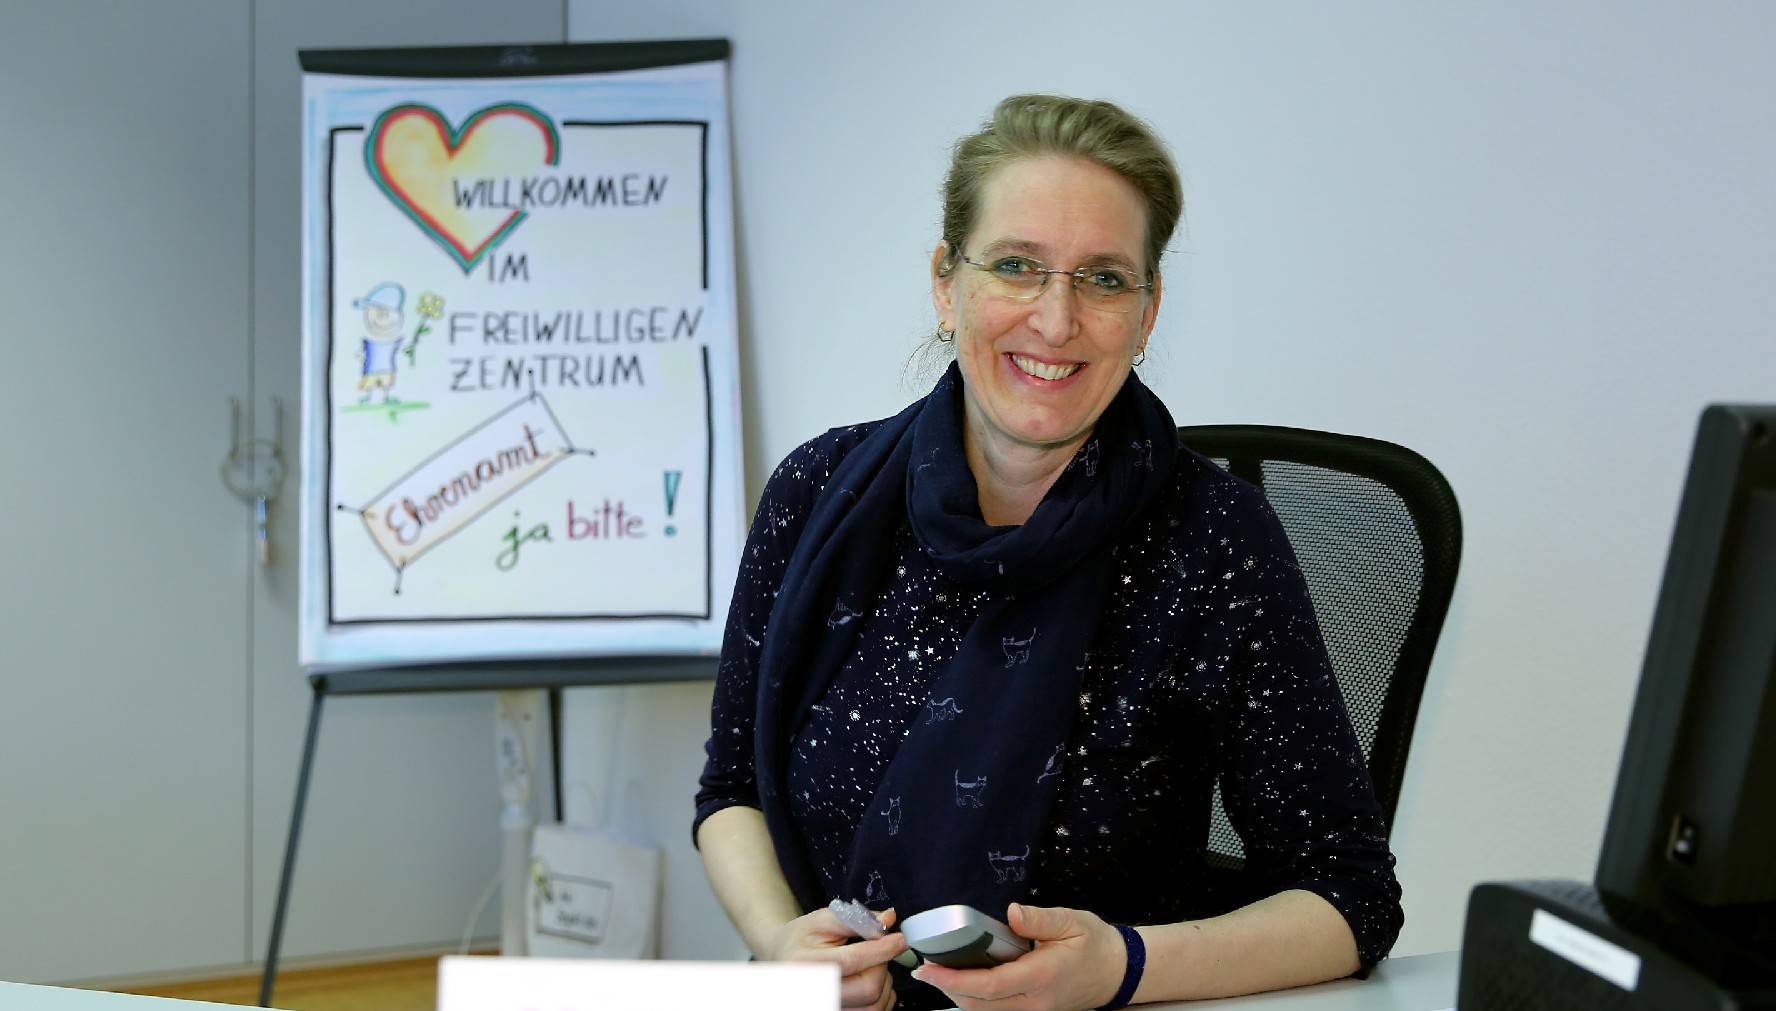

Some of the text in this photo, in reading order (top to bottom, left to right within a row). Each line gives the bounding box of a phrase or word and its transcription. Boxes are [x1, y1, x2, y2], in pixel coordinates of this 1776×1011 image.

[453, 174, 668, 209] WILLKOMMEN
[487, 251, 530, 283] IM
[449, 308, 703, 345] FREIWILLIGEN
[449, 355, 646, 393] ZENTRUM
[384, 424, 547, 546] Ehrenamt
[494, 510, 554, 572] ja
[565, 500, 647, 541] bitte
